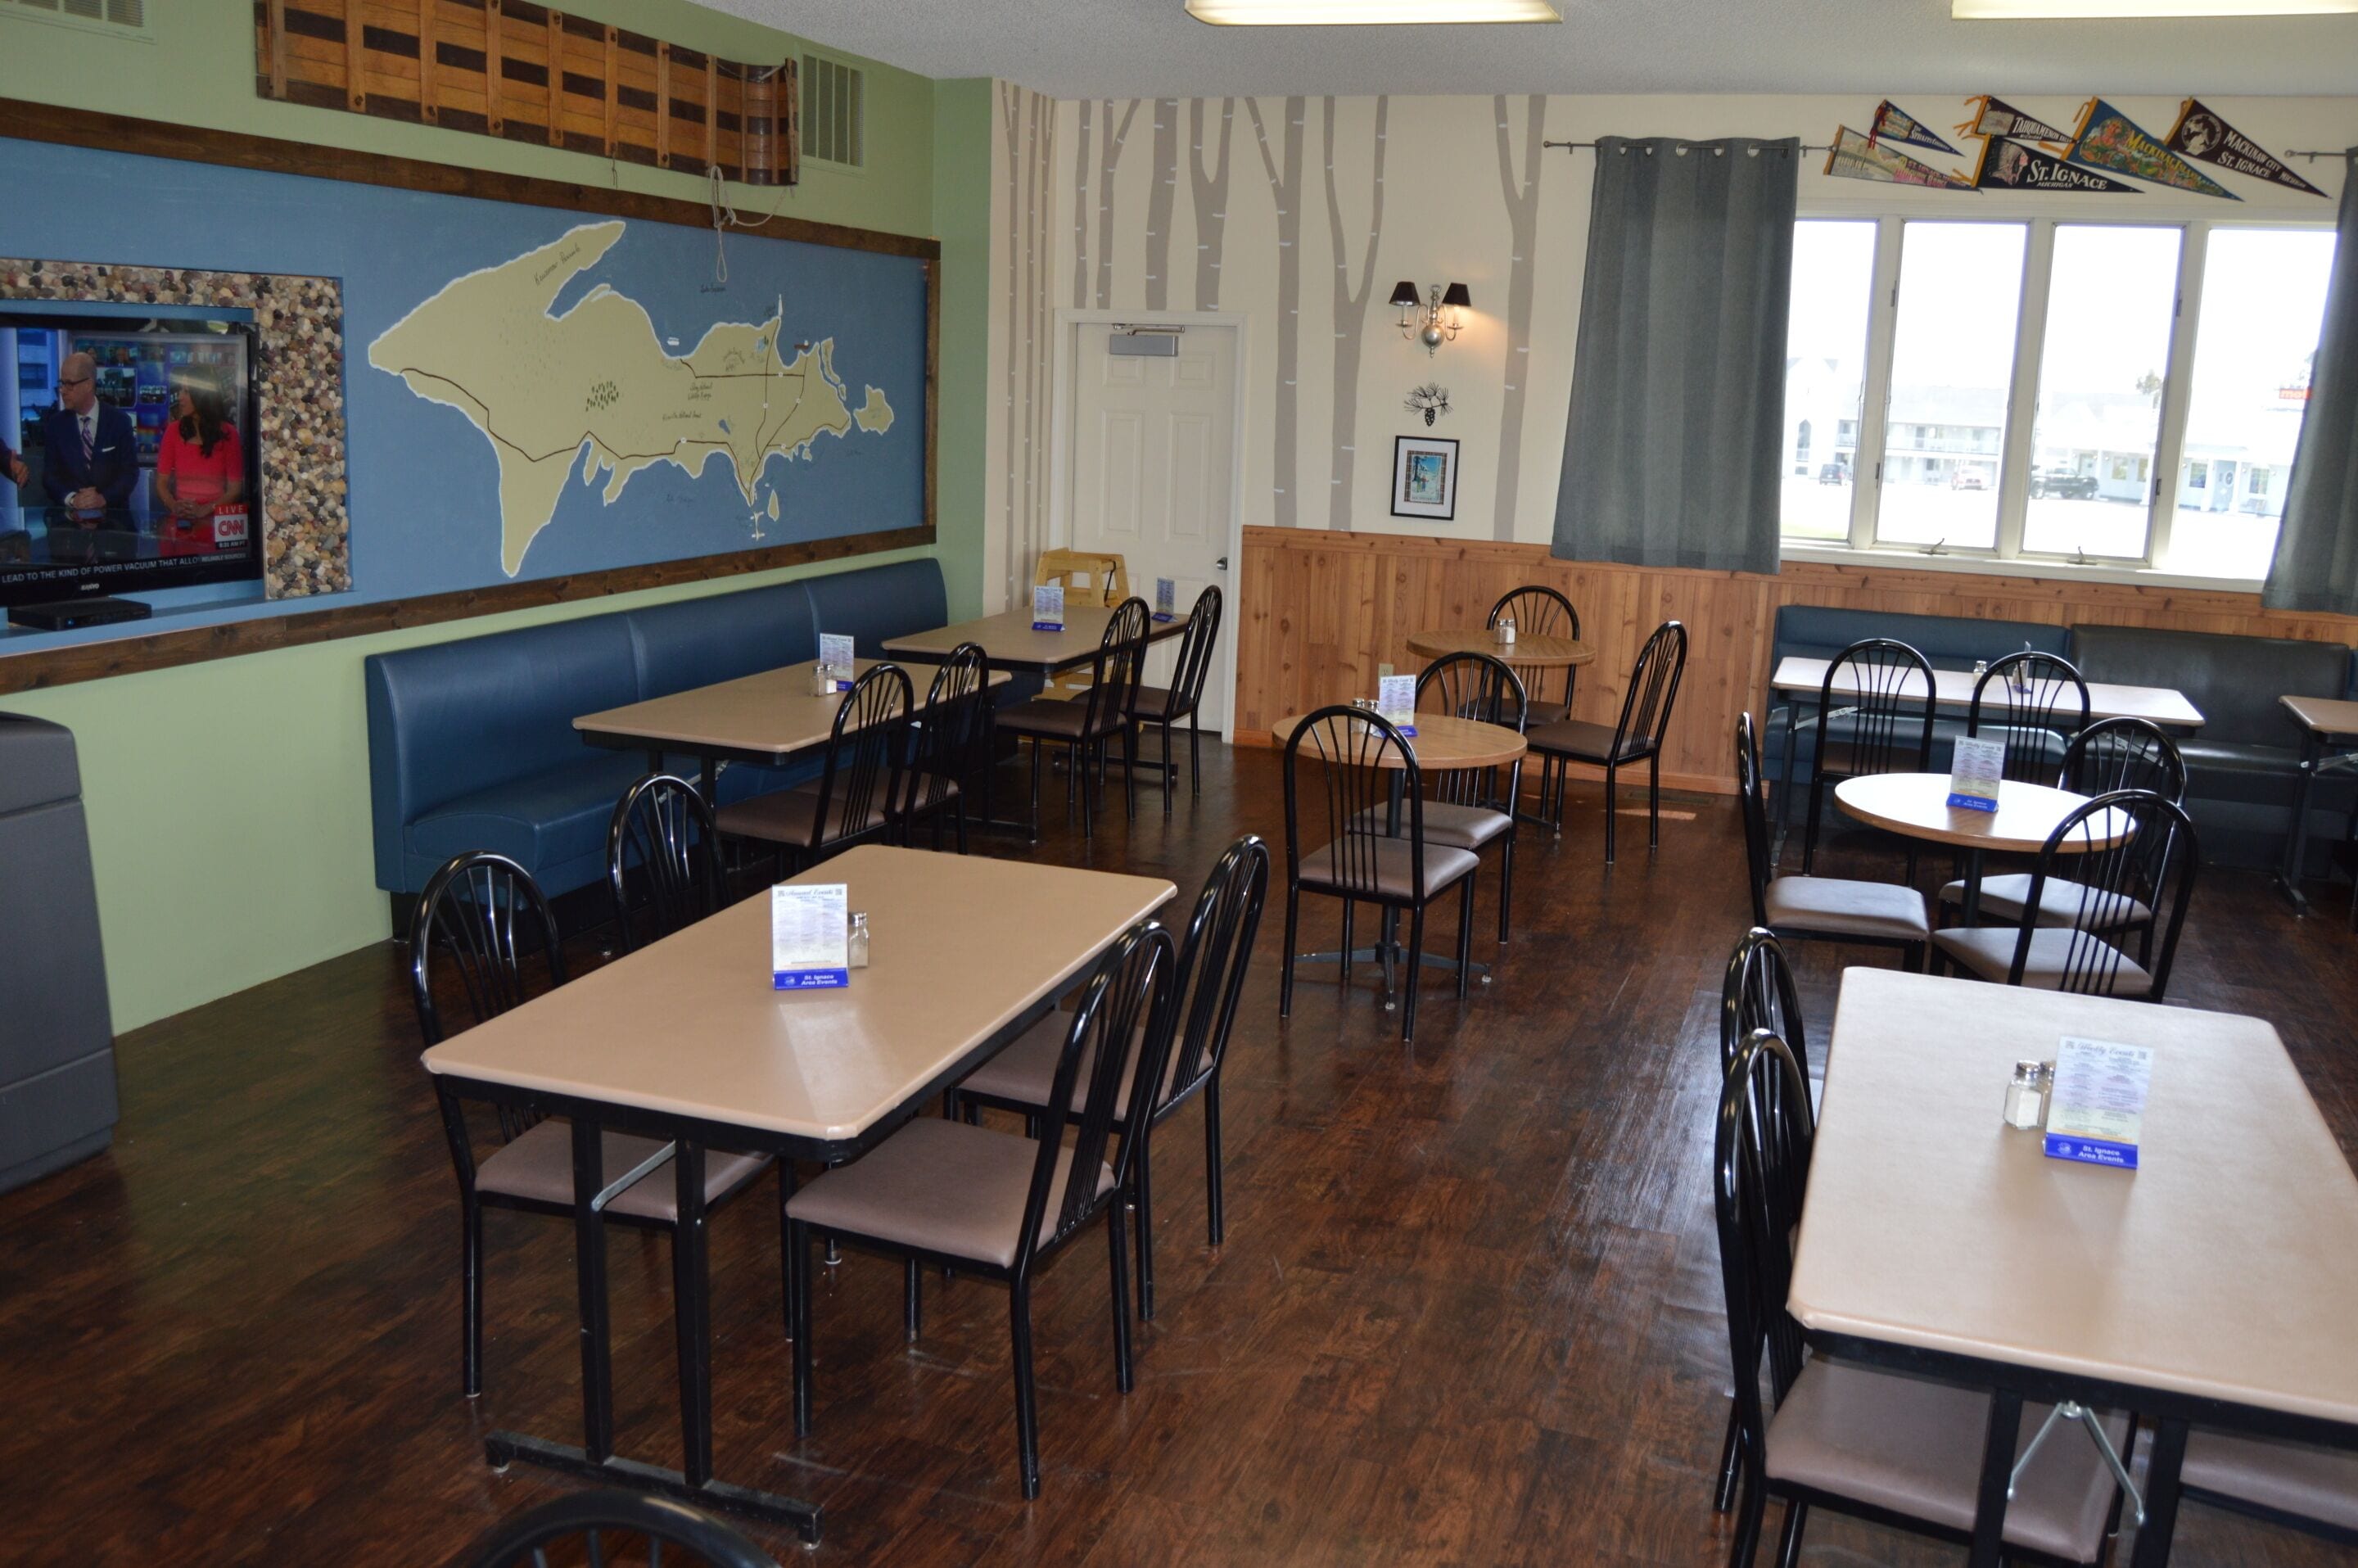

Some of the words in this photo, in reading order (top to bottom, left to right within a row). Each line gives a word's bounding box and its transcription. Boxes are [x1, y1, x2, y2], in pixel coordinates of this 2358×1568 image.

[2223, 130, 2268, 166] MACKINAW
[2265, 160, 2283, 173] CITY
[2026, 160, 2049, 183] ST.
[2052, 163, 2109, 190] IGNACE
[2217, 151, 2233, 168] ST.
[2235, 158, 2271, 178] IGNACE
[219, 504, 243, 515] LIVE
[219, 519, 245, 536] CNN
[2, 574, 25, 583] LEAD
[27, 572, 38, 581] TO
[40, 571, 56, 579] THE
[59, 568, 79, 577] KIND
[80, 567, 91, 575] OF
[94, 564, 122, 573] POWER
[124, 561, 157, 571] VACUUM
[160, 558, 177, 567] THAT
[179, 557, 198, 566] ALLO
[2078, 1151, 2096, 1160] Area
[2098, 1155, 2124, 1164] Events
[2094, 1146, 2120, 1156] Ignace
